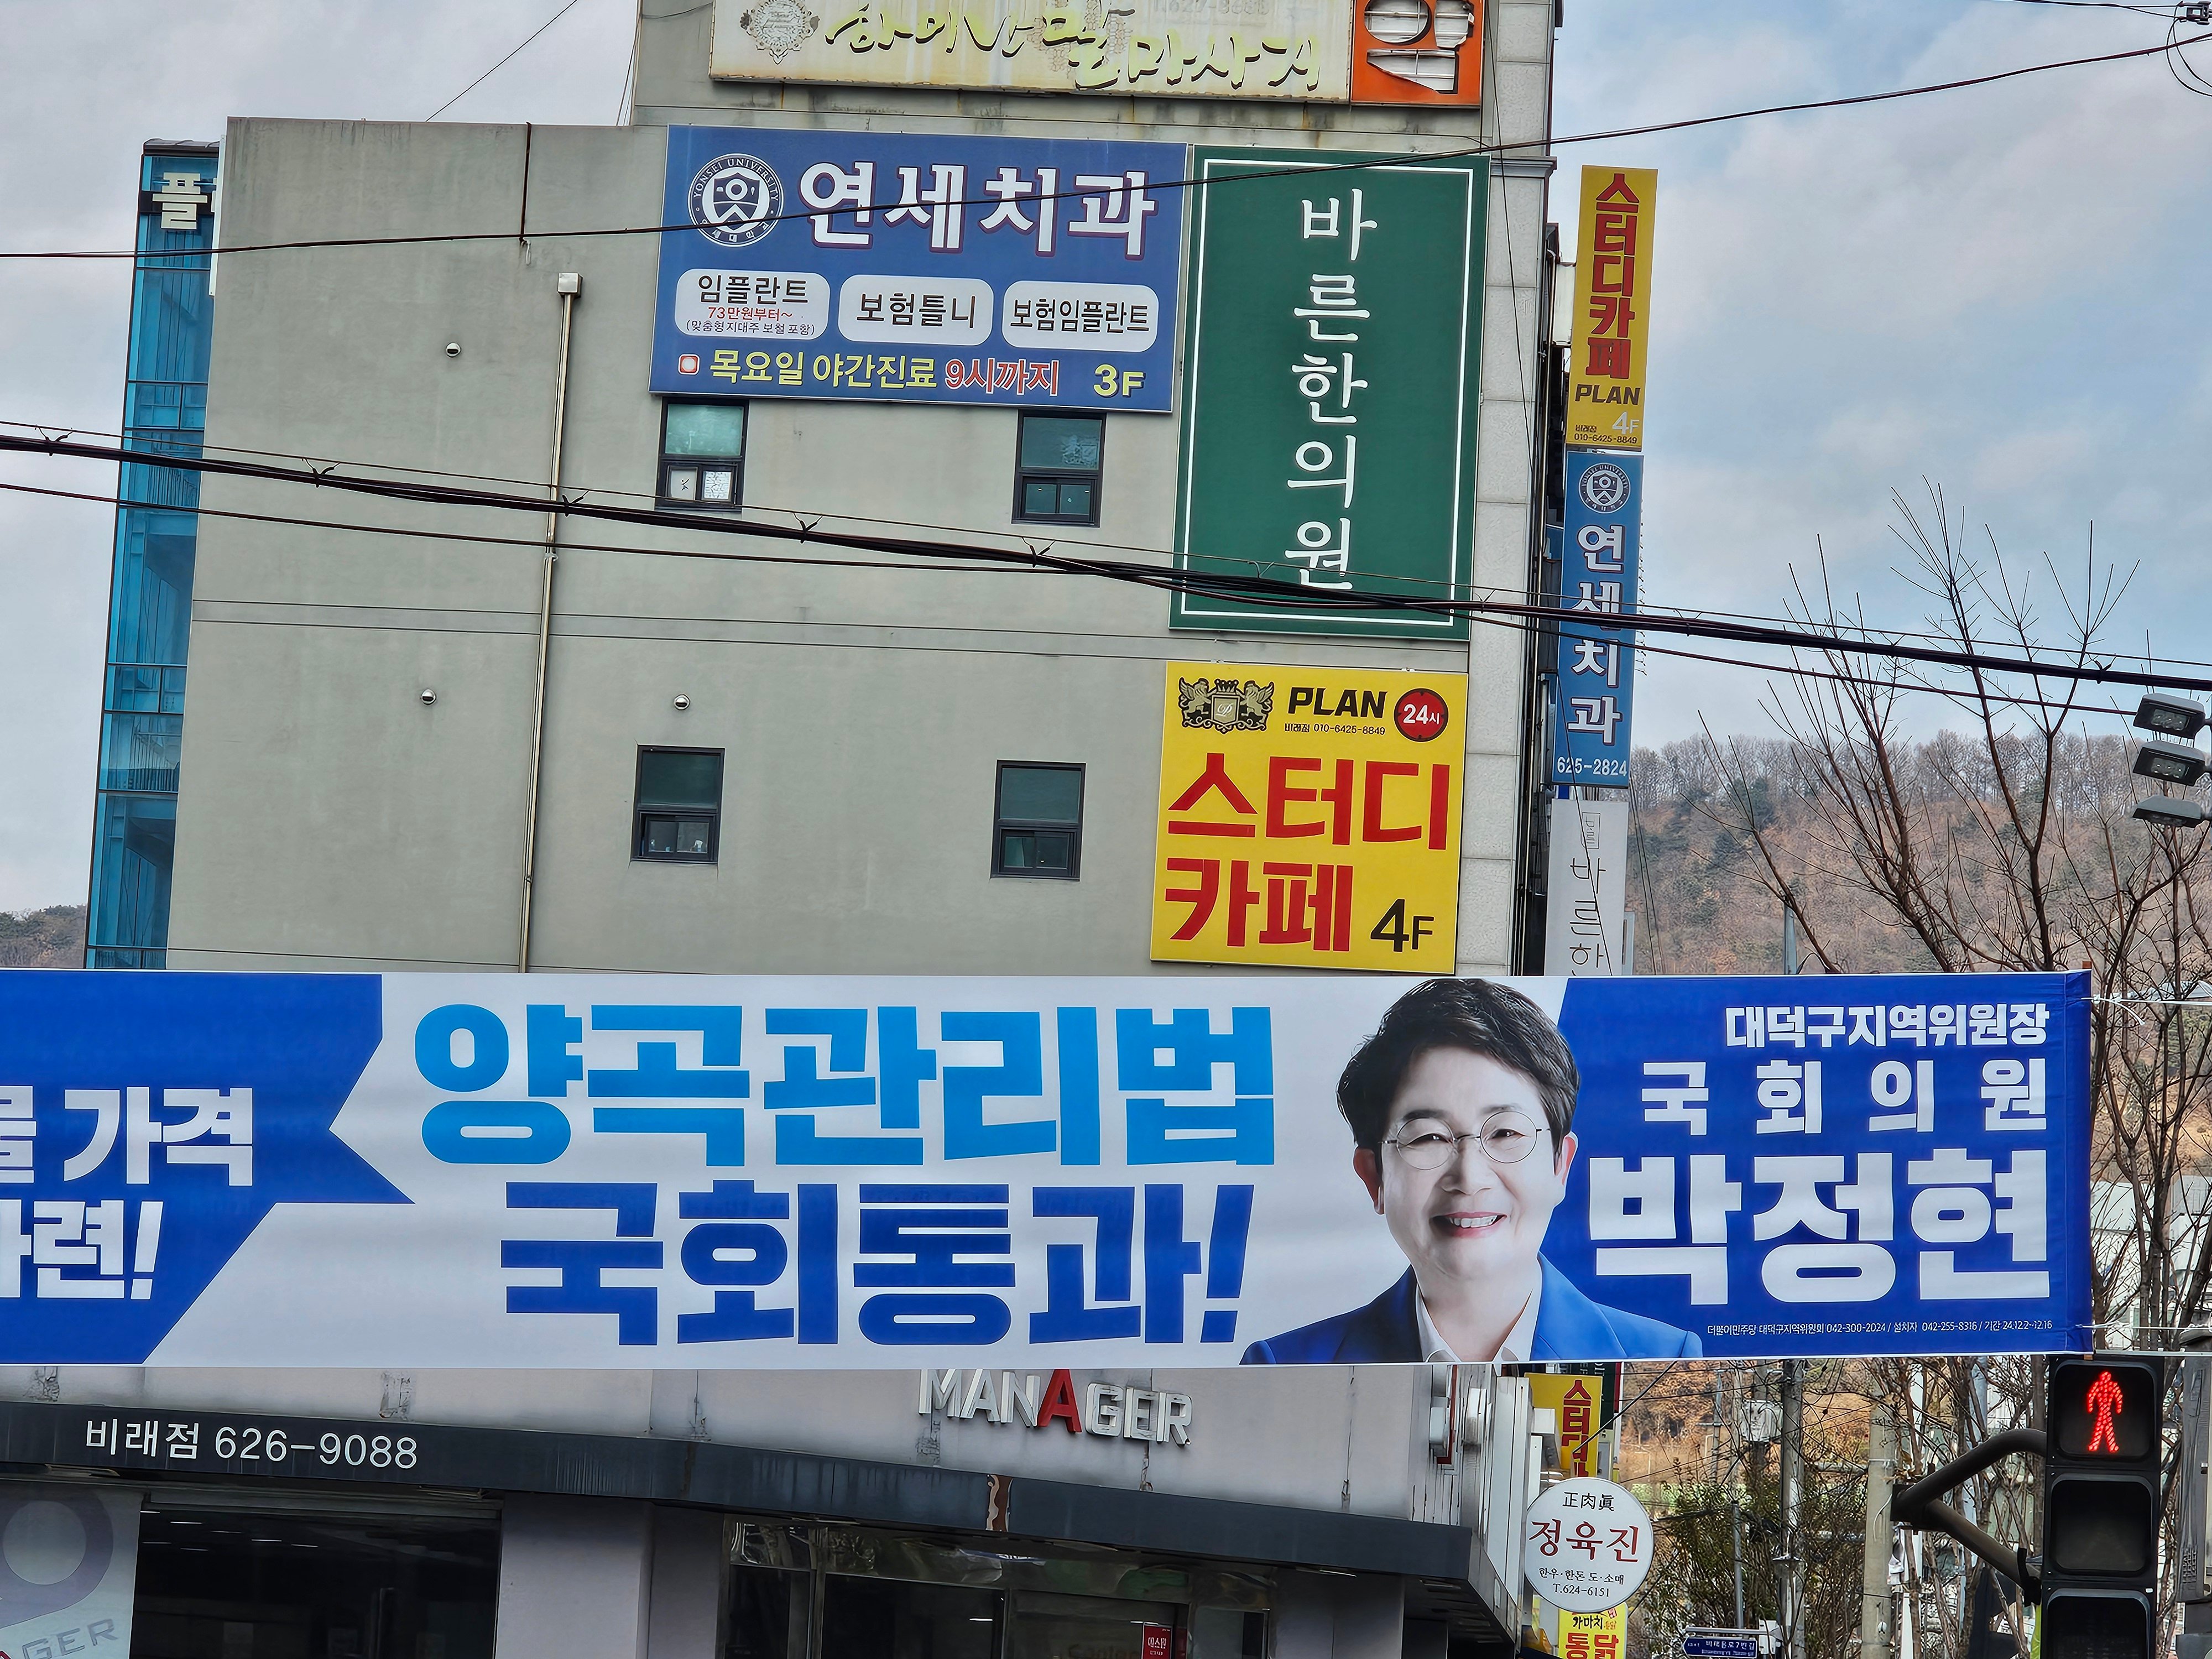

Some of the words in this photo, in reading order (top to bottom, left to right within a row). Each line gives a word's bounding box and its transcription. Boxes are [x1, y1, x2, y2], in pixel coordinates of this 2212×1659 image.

[152, 172, 217, 229] 플
[693, 161, 723, 198] YONSEI
[727, 158, 779, 201] UNIVERSITY
[800, 161, 1157, 260] 연세치과
[698, 275, 808, 305] 임플란트
[1585, 173, 1640, 379] 스터디카페
[859, 291, 975, 330] 보험틀니
[1009, 296, 1151, 334] 보험임플란트
[710, 350, 804, 386] 목요일
[813, 353, 938, 389] 야간진료
[945, 359, 1060, 397] 9시까지
[1094, 363, 1146, 398] 3F
[1284, 188, 1378, 590] 바른한의원
[1574, 384, 1641, 405] PLAN
[1574, 433, 1637, 444] 010-6425-8849
[1612, 411, 1640, 435] 4F
[1567, 524, 1626, 745] 연세치과
[1288, 686, 1389, 718] PLAN
[1402, 703, 1440, 725] 24시
[1313, 723, 1386, 735] 010-6425-8849
[1556, 756, 1628, 777] 625-2824
[1167, 753, 1451, 851] 스터디
[1165, 857, 1354, 952] 카페
[1369, 899, 1435, 952] 4F
[1726, 1003, 2050, 1048] 대덕구지역위원장
[414, 1003, 1275, 1166] 양곡관리법
[64, 1086, 253, 1186] 가격
[1589, 1147, 2050, 1306] 박정현
[499, 1180, 1255, 1347] 국회통과!
[918, 1369, 1193, 1446] MANAGER
[85, 1418, 200, 1460] 비래점
[215, 1426, 418, 1469] 626-9088
[1528, 1518, 1639, 1563] 정육진
[1552, 1583, 1609, 1597] T.624-6151
[0, 1619, 119, 1659] GER
[1572, 1614, 1603, 1630] 가마치
